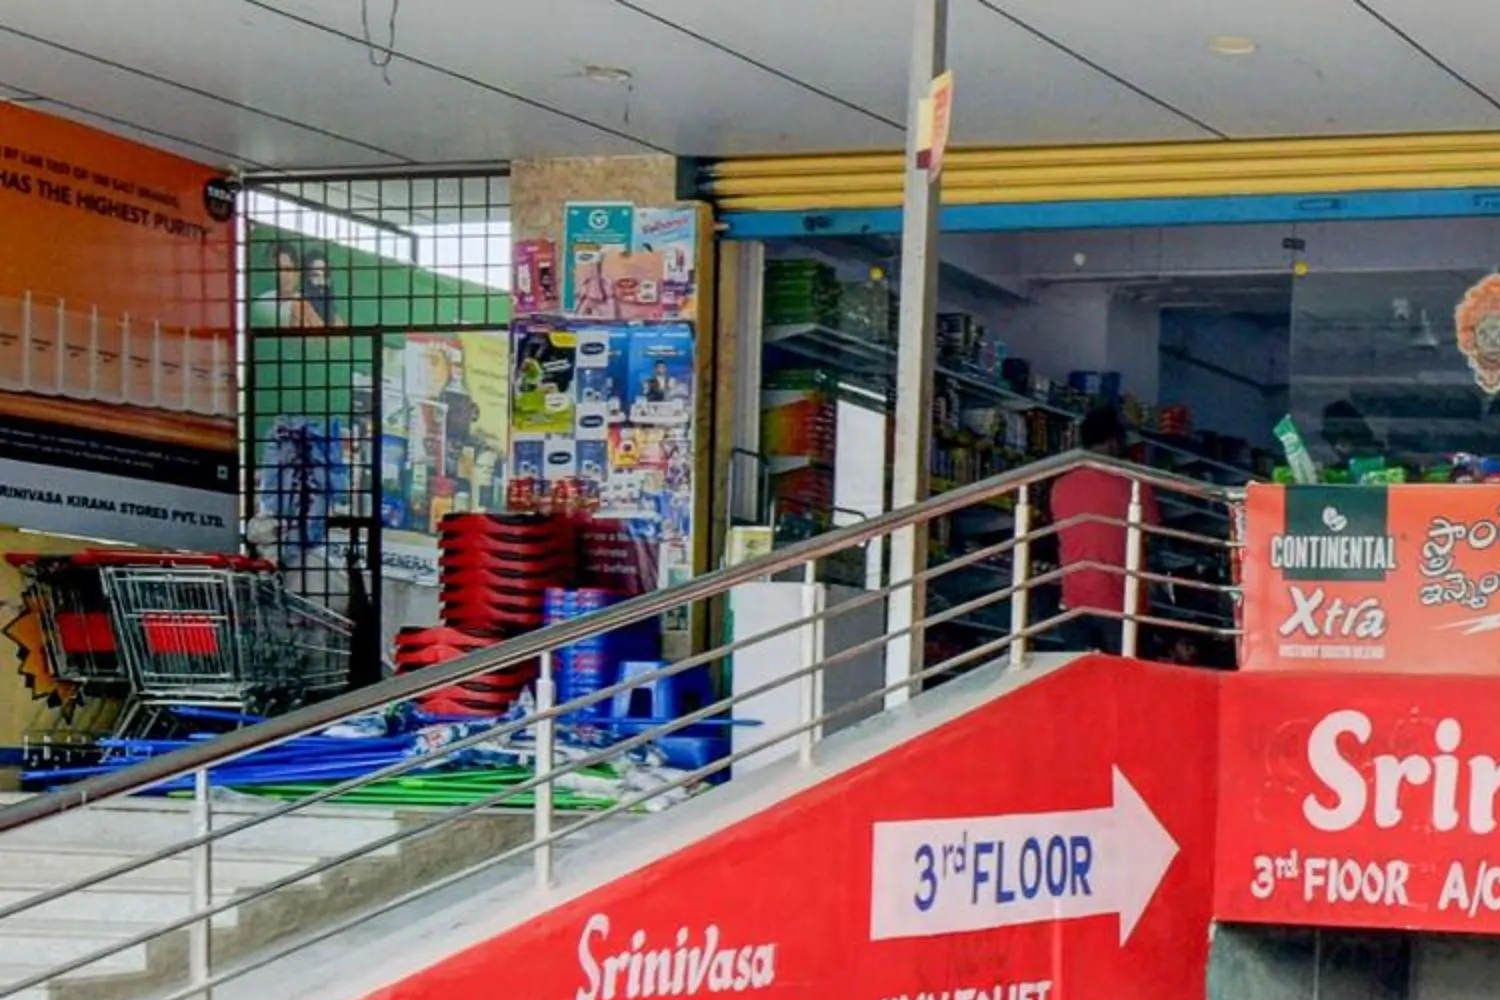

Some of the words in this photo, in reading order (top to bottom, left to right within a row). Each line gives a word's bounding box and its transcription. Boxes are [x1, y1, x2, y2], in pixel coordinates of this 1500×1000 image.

[37, 179, 71, 207] THE
[76, 189, 150, 226] HIGHEST
[153, 213, 209, 240] PURITY
[0, 484, 62, 504] RINIVASA
[67, 495, 116, 513] KIRANA
[120, 502, 168, 521] STORES
[1270, 535, 1396, 570] CONTINENTAL
[1279, 586, 1386, 639] Xtra
[914, 830, 969, 912] 3rd
[972, 834, 1093, 906] FLOOR
[1251, 849, 1298, 899] 3rd
